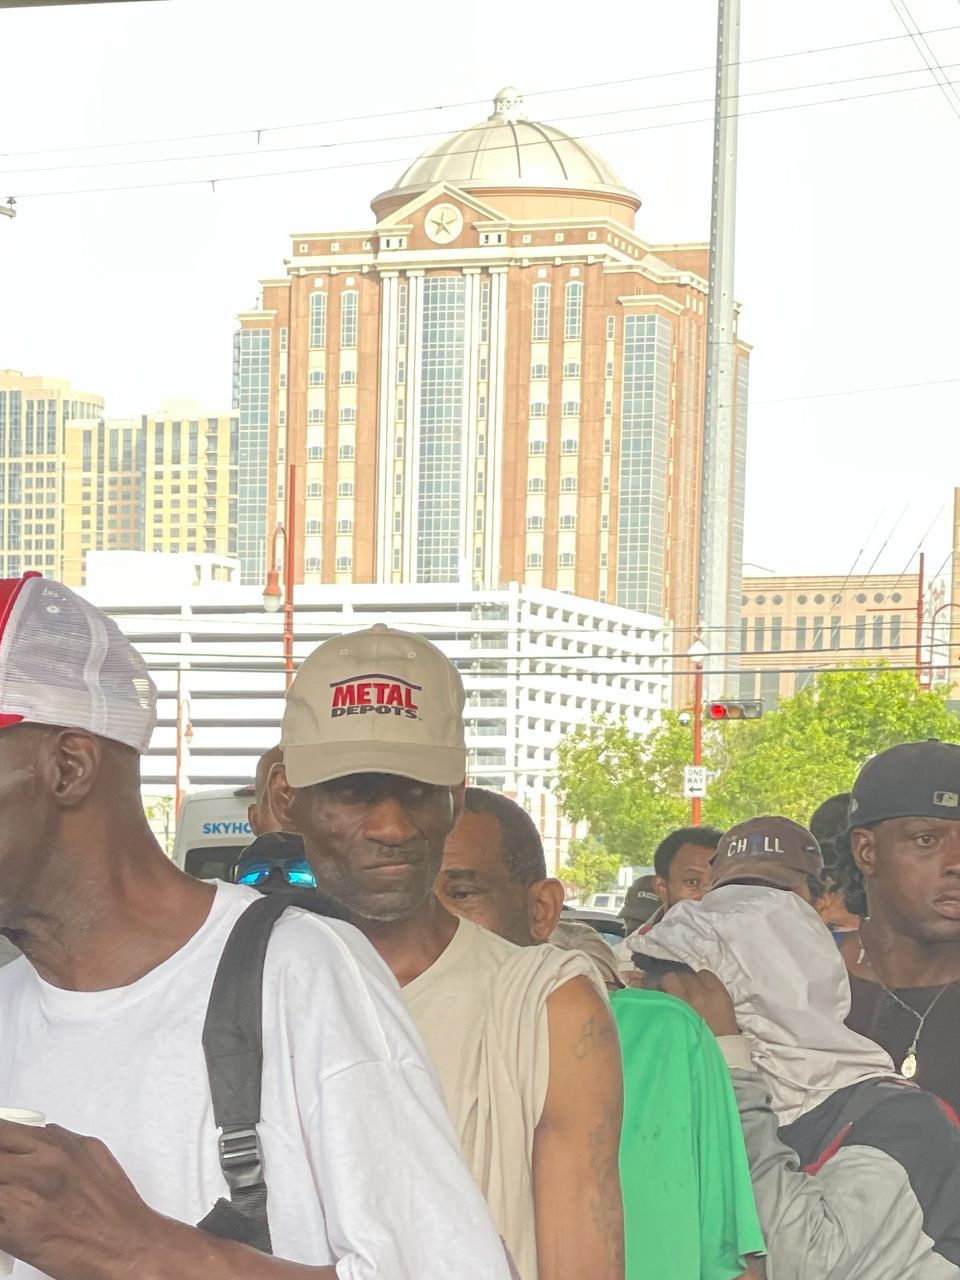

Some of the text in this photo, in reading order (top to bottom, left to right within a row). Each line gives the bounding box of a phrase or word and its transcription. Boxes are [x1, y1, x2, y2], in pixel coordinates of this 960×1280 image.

[332, 683, 418, 710] METAL
[331, 705, 418, 719] DEPOTS
[687, 768, 704, 777] ONE
[686, 777, 704, 785] WAY
